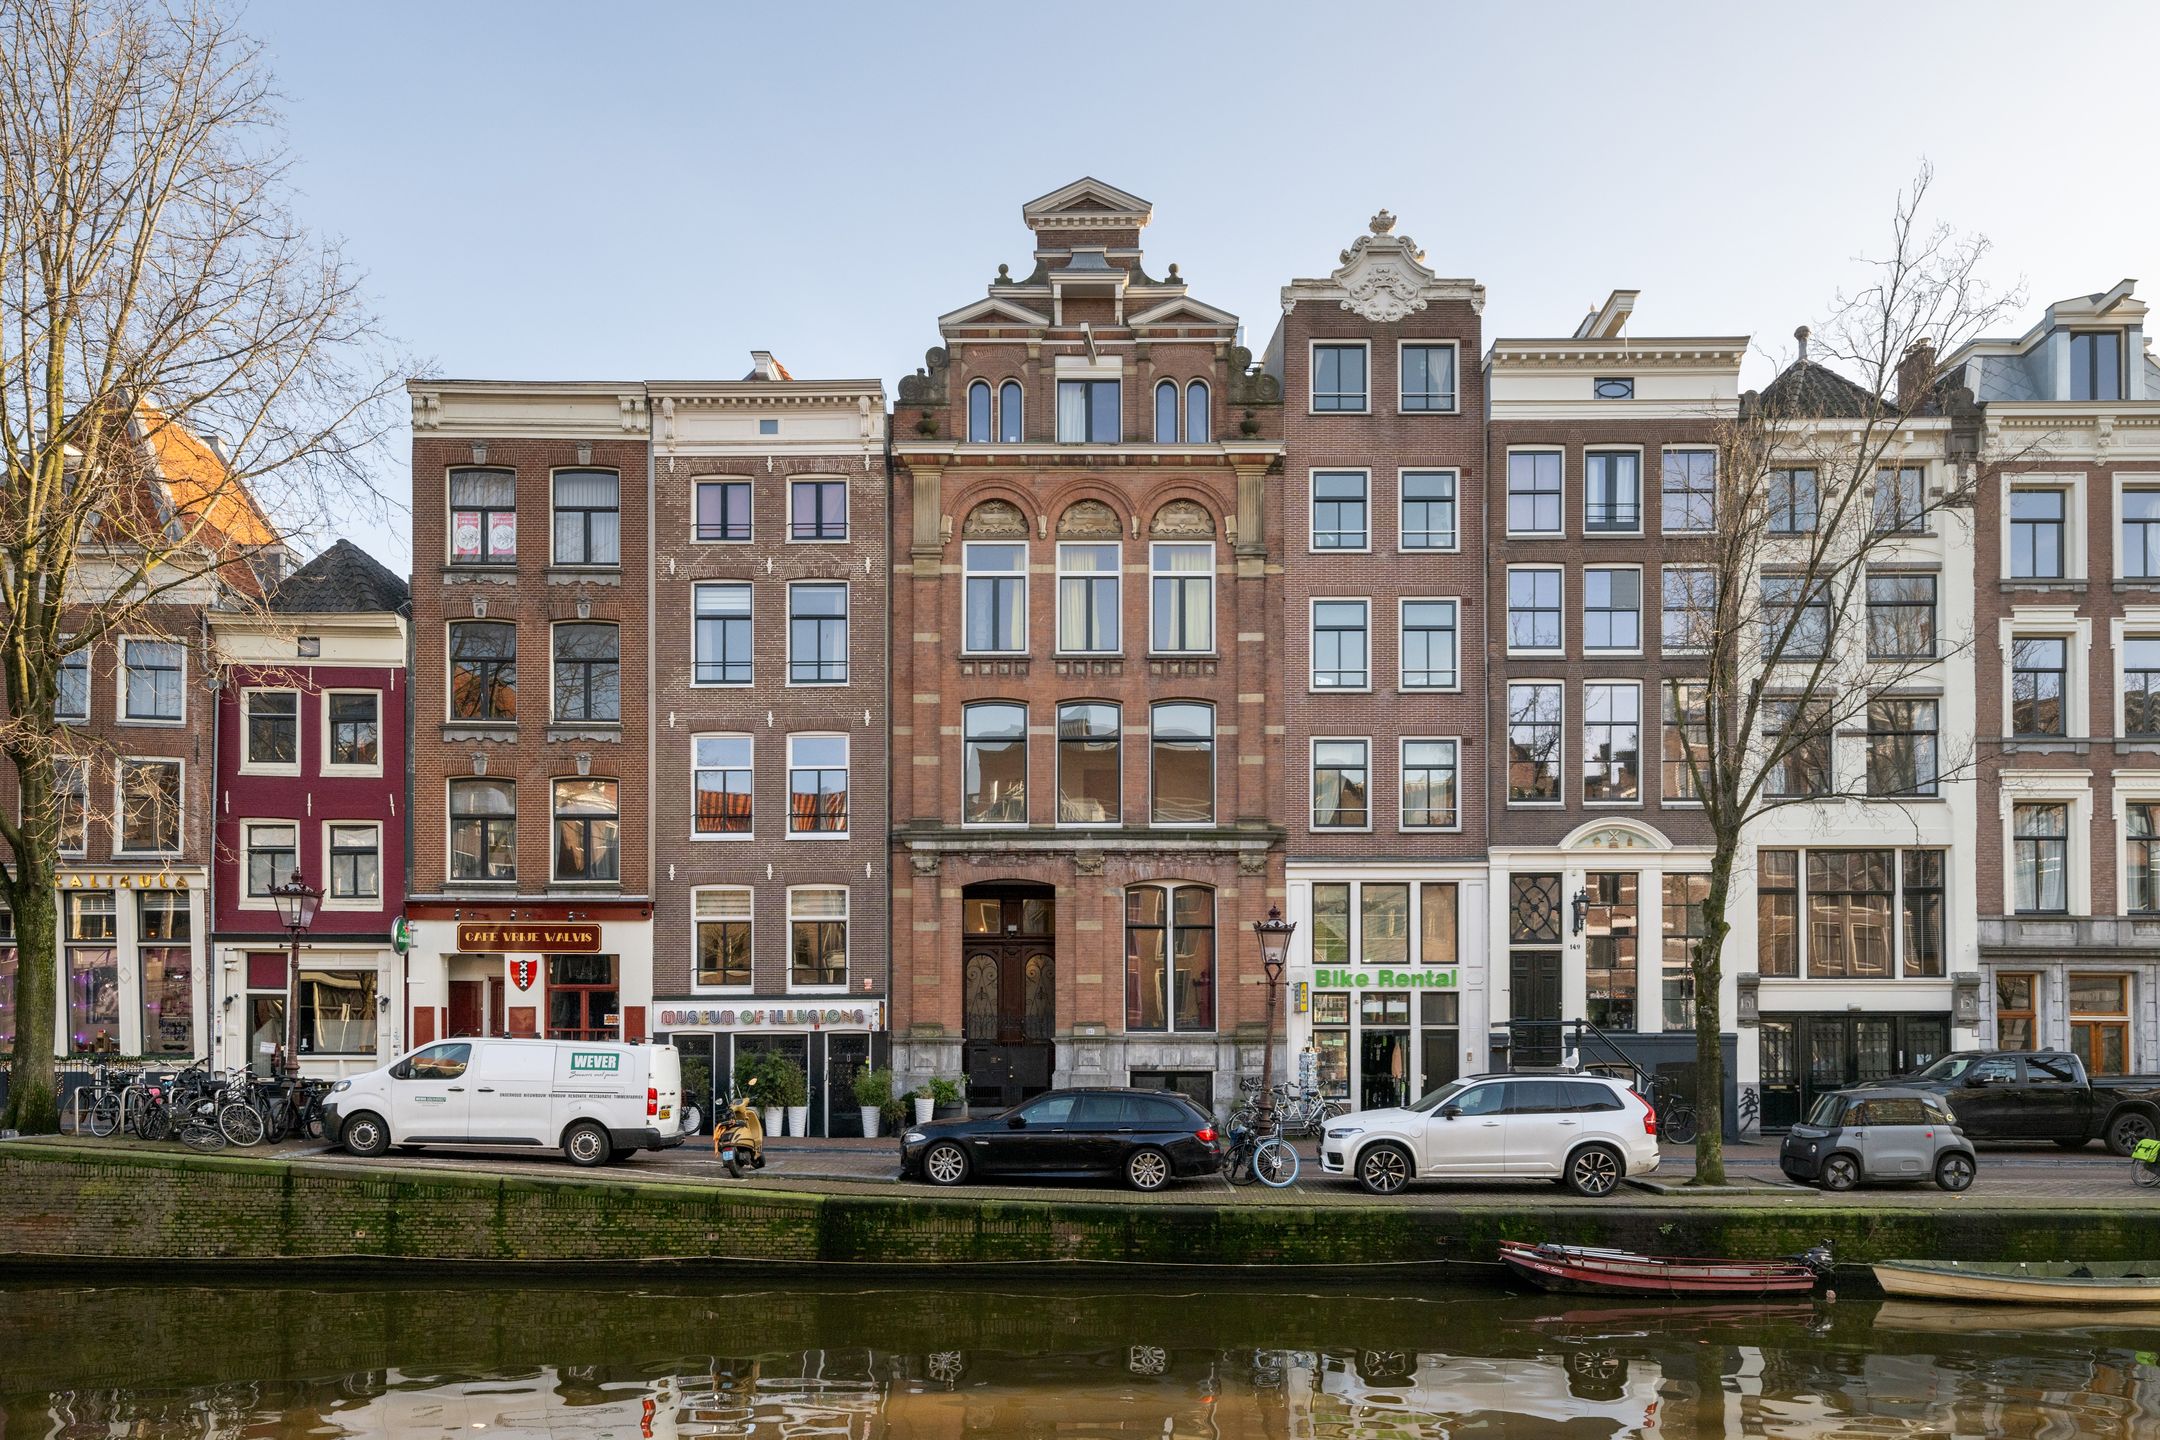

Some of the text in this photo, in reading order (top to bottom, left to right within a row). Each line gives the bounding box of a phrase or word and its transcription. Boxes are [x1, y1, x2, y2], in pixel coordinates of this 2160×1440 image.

[55, 872, 189, 888] CALIGULA
[465, 932, 593, 942] CAFE VRIJE WALVIS
[1315, 969, 1457, 987] Bike Rental
[661, 1009, 865, 1025] MUSEUM OF ILLUSIONS
[574, 1055, 617, 1068] WEVER
[1534, 1262, 1550, 1271] Comic
